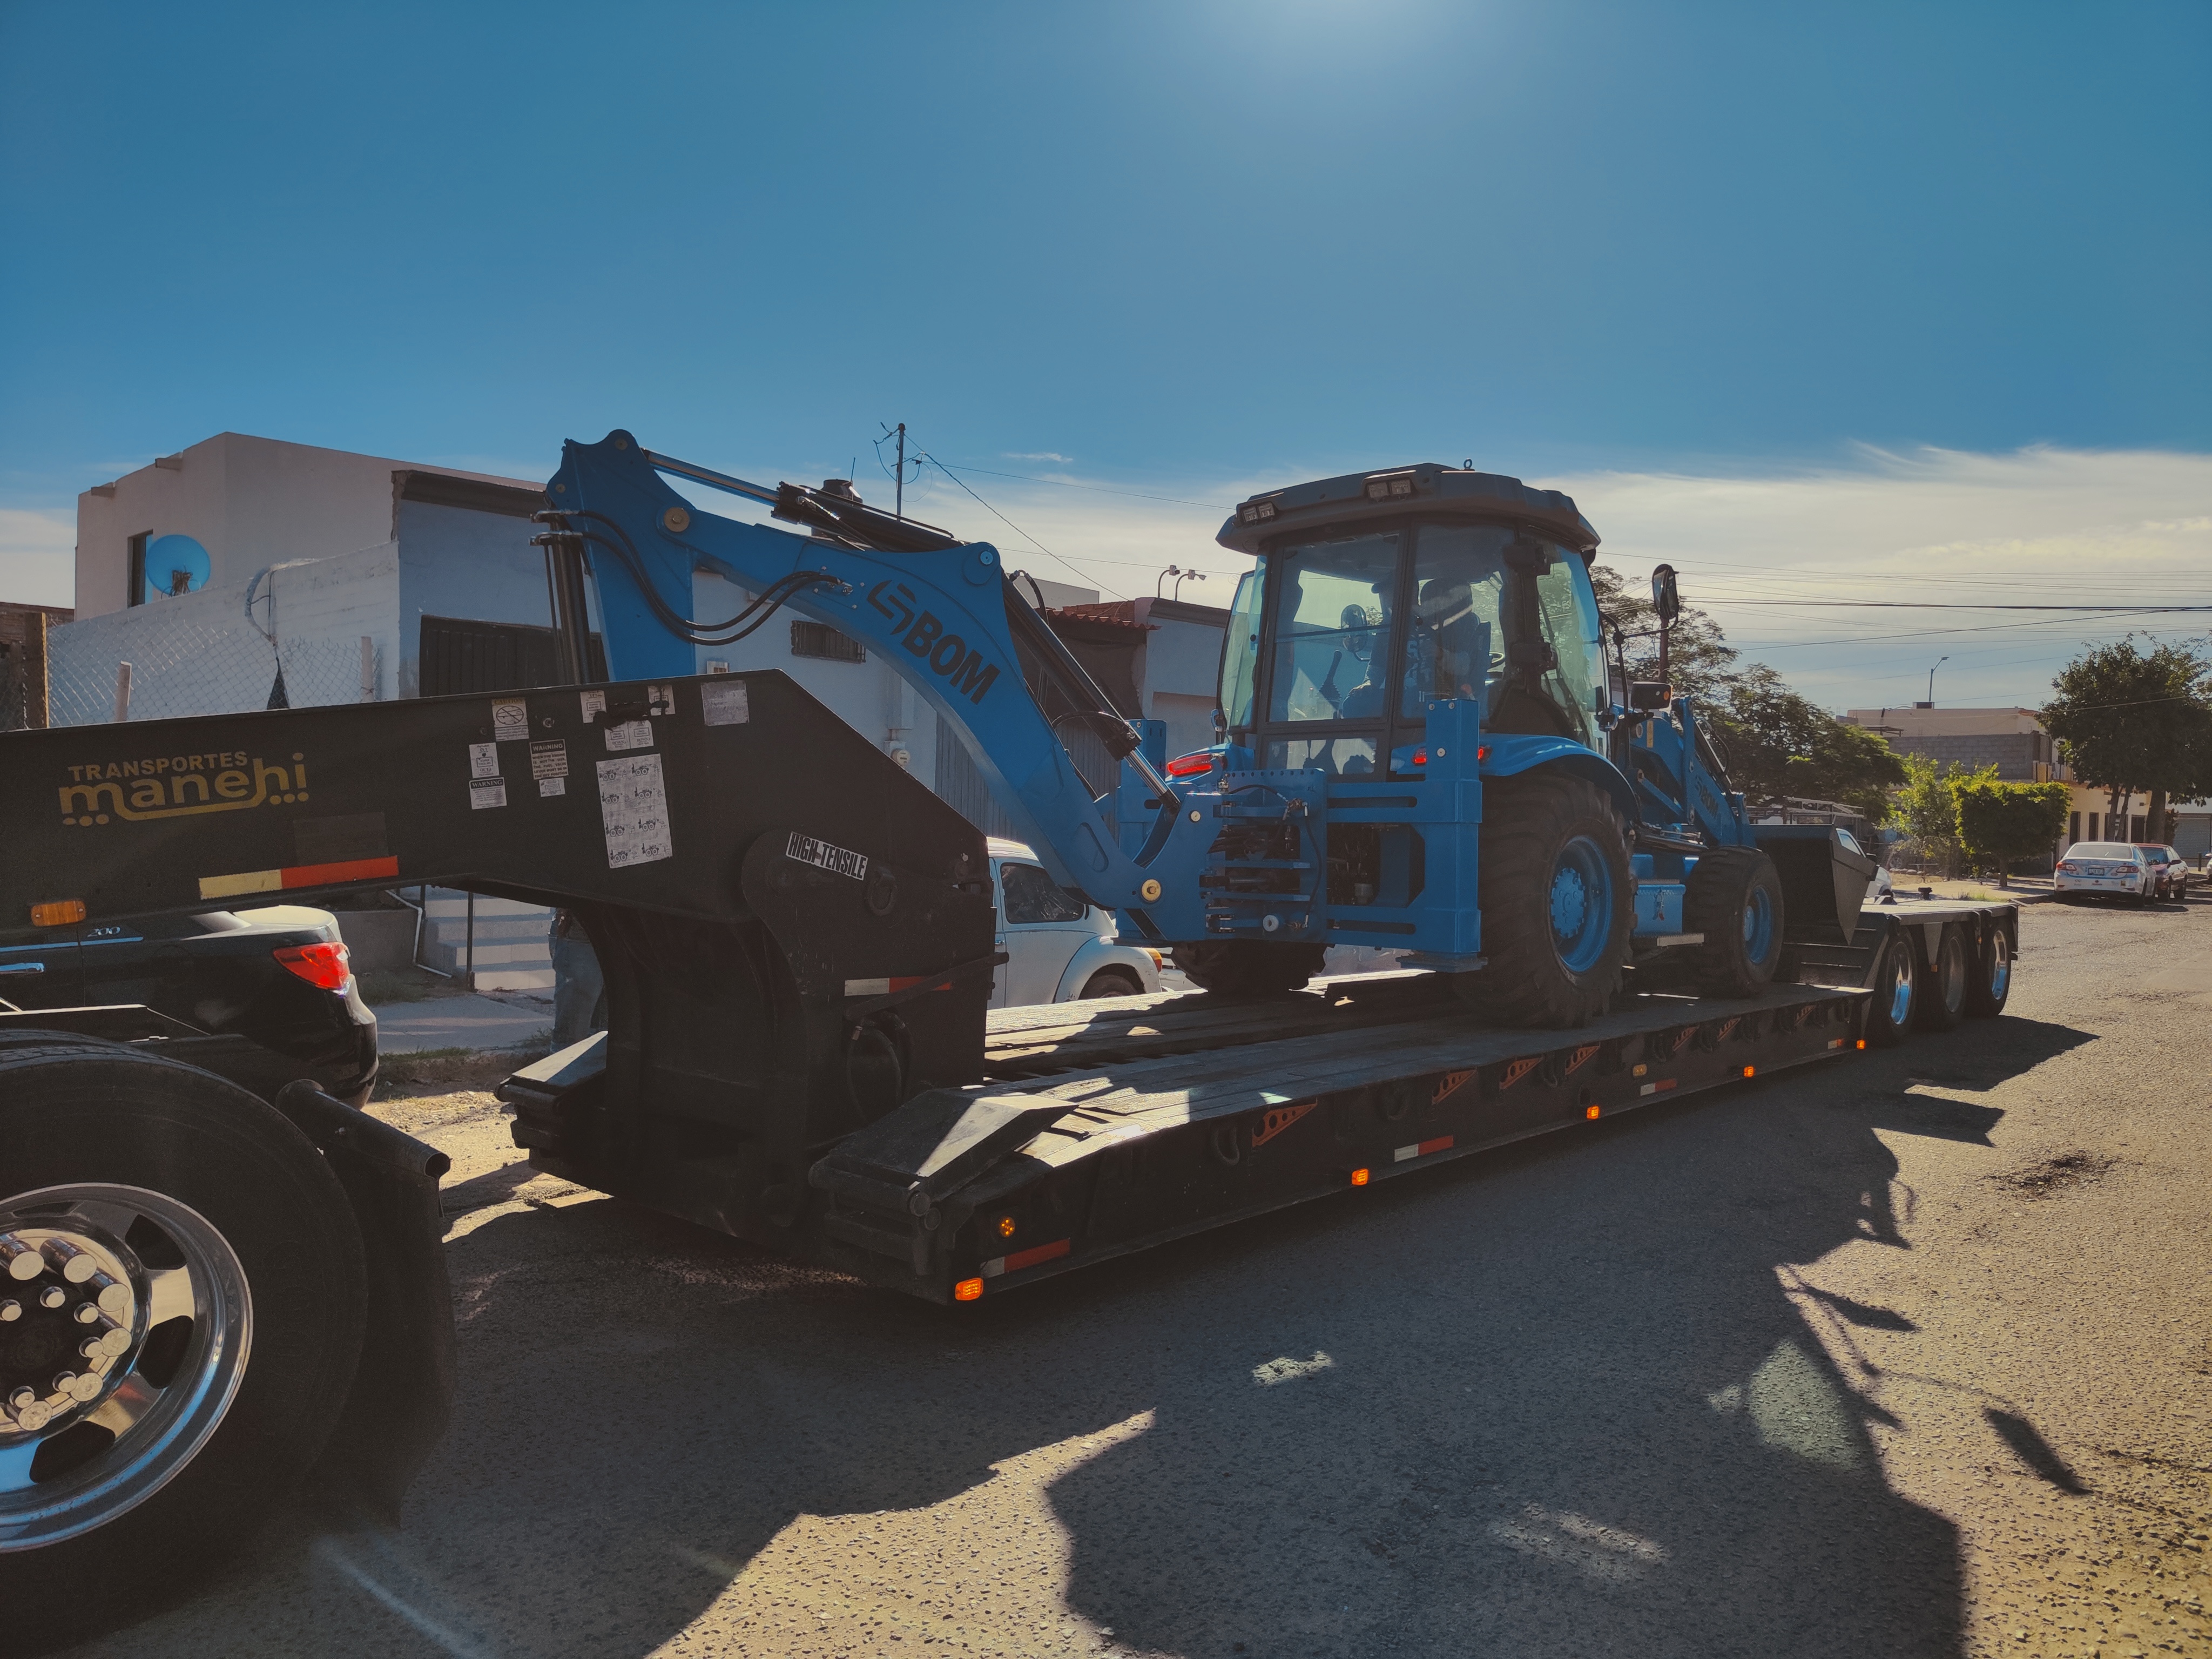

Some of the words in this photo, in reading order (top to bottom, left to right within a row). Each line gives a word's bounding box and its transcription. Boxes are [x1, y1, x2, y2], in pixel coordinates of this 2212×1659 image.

[901, 610, 1001, 705] BOM
[532, 743, 563, 751] WARNING
[68, 751, 249, 781] TRANSPORTES
[59, 752, 309, 821] manehi
[472, 779, 502, 787] WARNING
[788, 833, 819, 863] HIGH
[820, 844, 867, 879] TENSILE
[87, 926, 120, 938] 200
